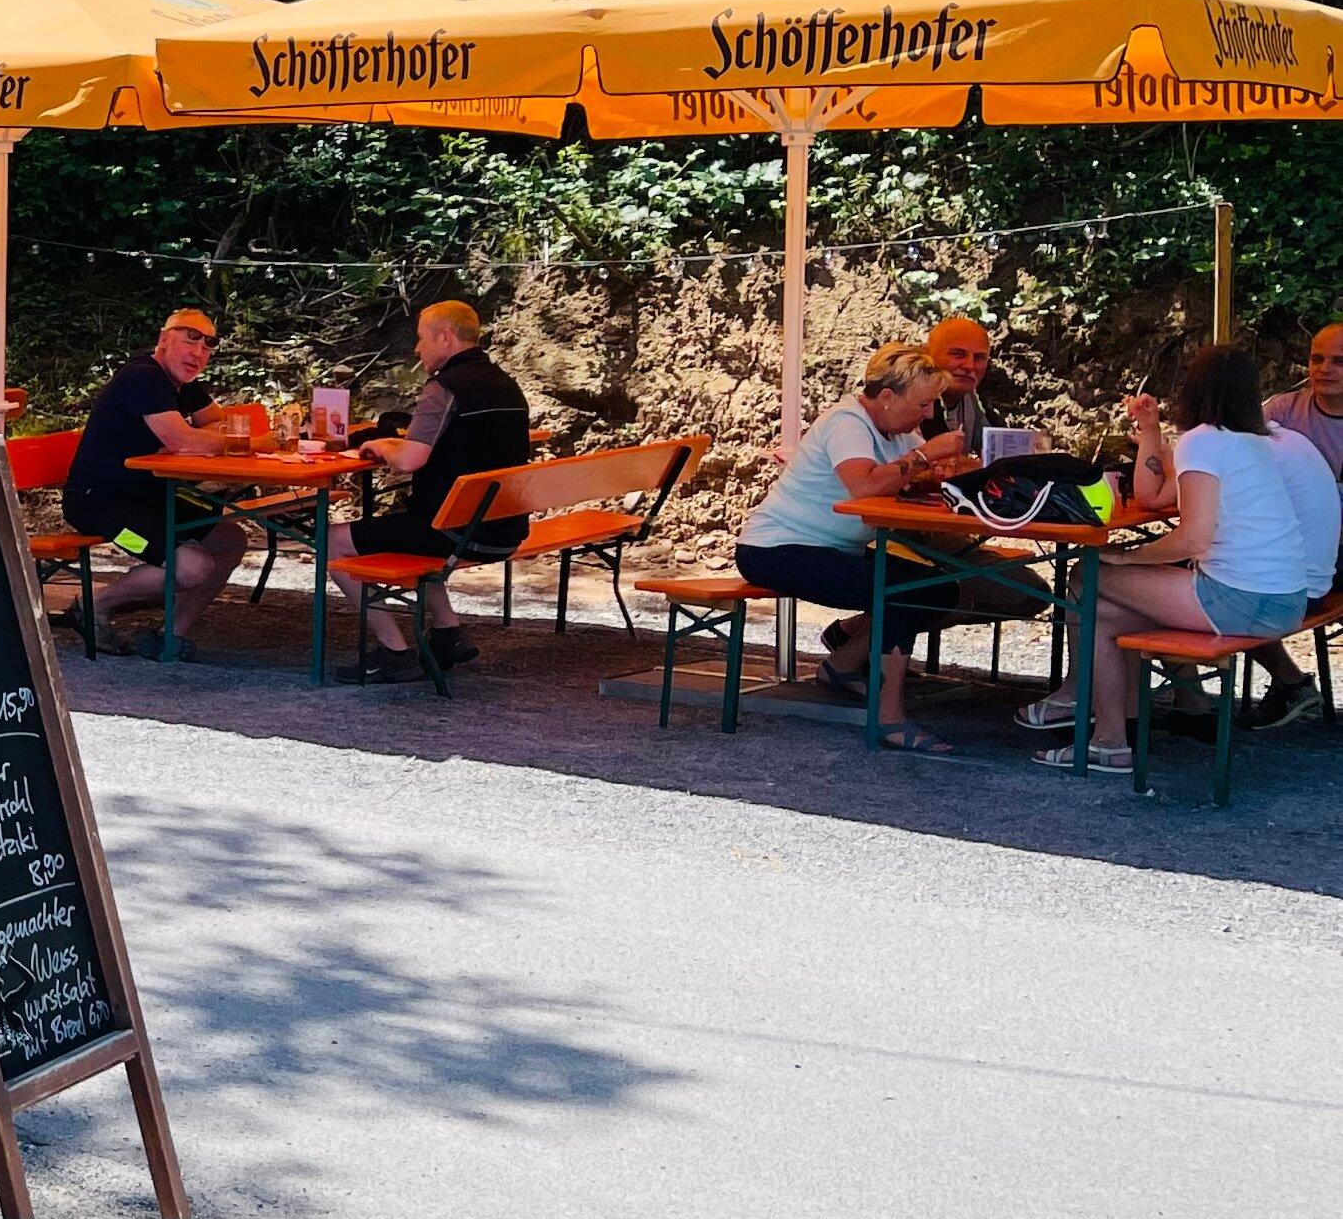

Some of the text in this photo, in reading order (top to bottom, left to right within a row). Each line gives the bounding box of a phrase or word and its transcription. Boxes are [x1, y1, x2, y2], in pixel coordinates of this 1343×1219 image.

[248, 28, 477, 98] Schöfferhofer
[703, 2, 998, 79] Schöfferhofer
[28, 853, 65, 887] 8,90
